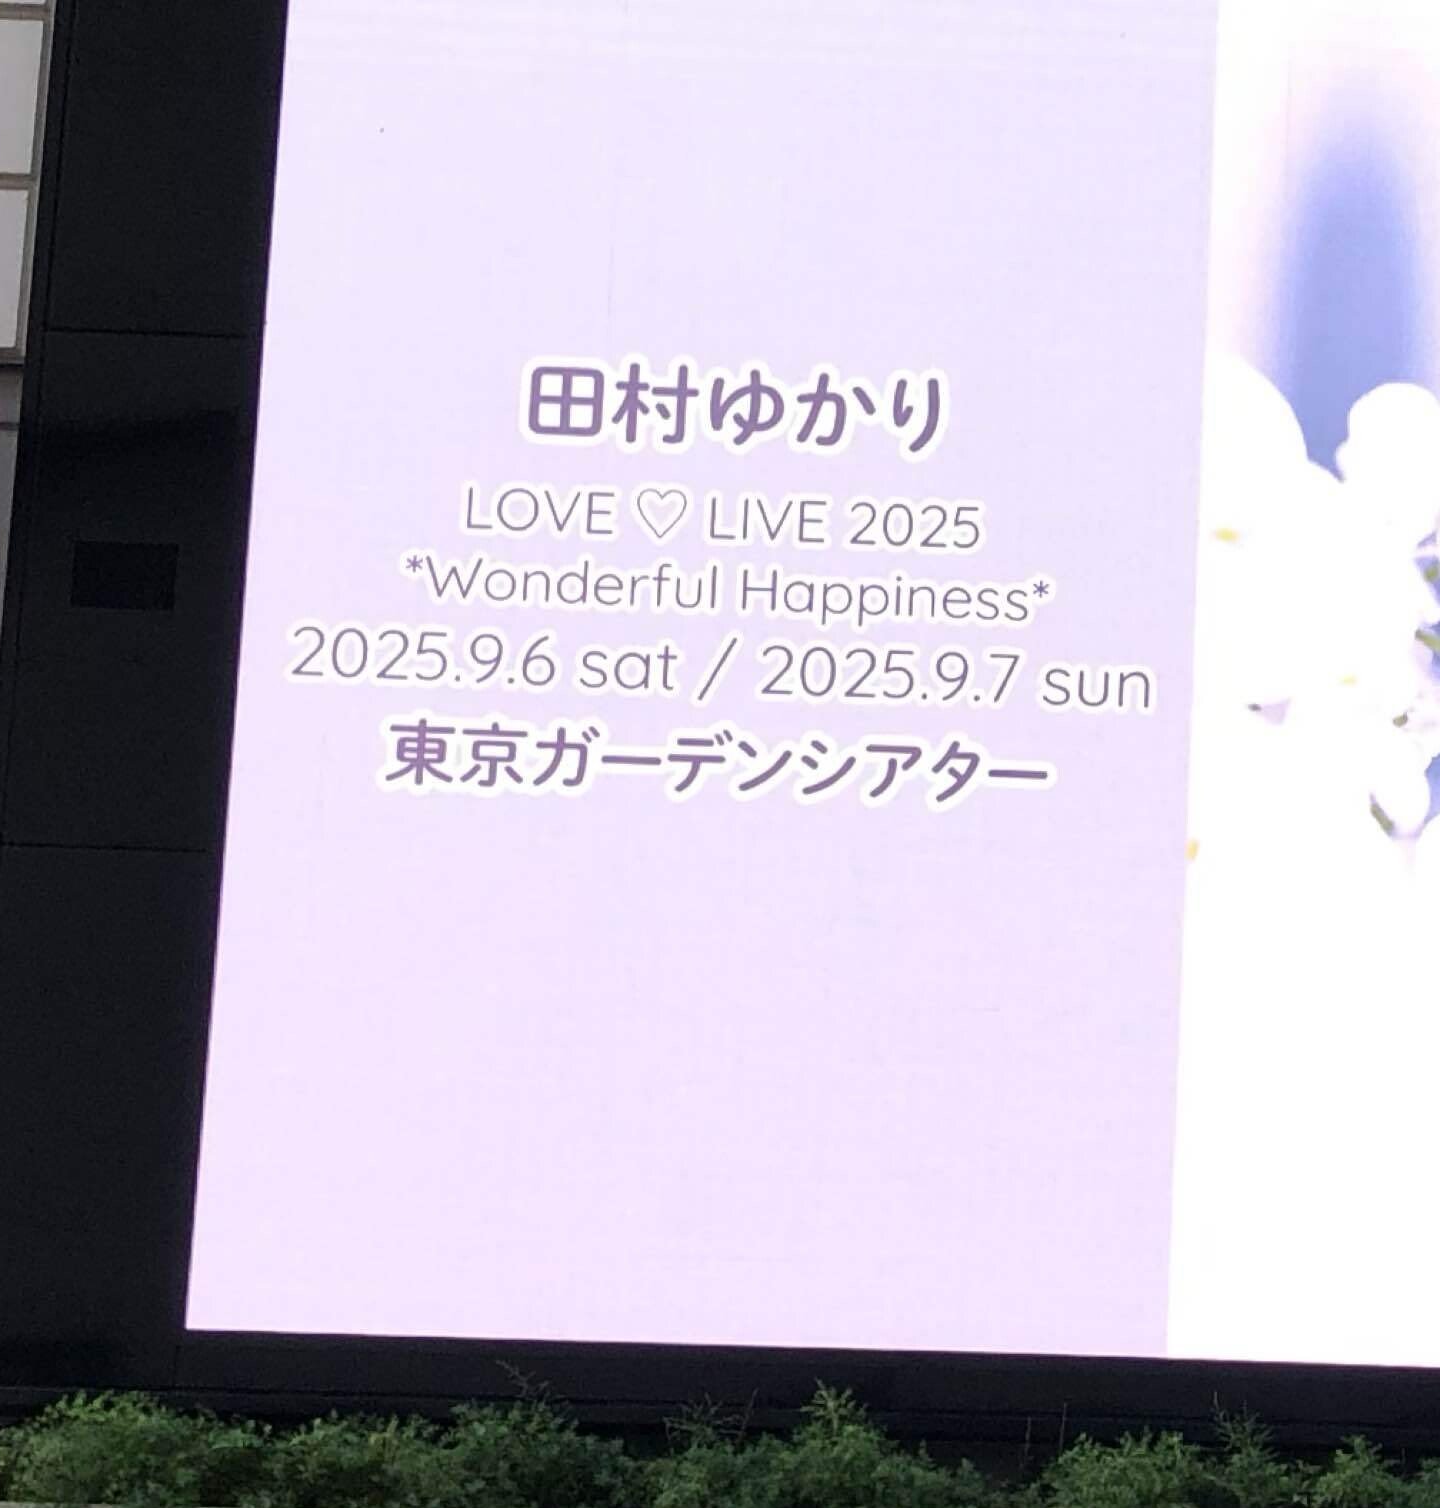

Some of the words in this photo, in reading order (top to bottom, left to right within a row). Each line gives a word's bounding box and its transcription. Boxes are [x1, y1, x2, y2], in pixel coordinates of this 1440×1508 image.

[527, 362, 942, 454] 田村ゆかり
[465, 486, 616, 535] LOVE
[708, 496, 828, 543] LIVE
[849, 502, 981, 549] 2025
[290, 626, 556, 686] 2025.9.6
[578, 645, 679, 692] sat
[760, 645, 1021, 704] 2025.9.7
[1041, 667, 1151, 708] sun
[384, 718, 1049, 803] 東京ガーデンシアター
